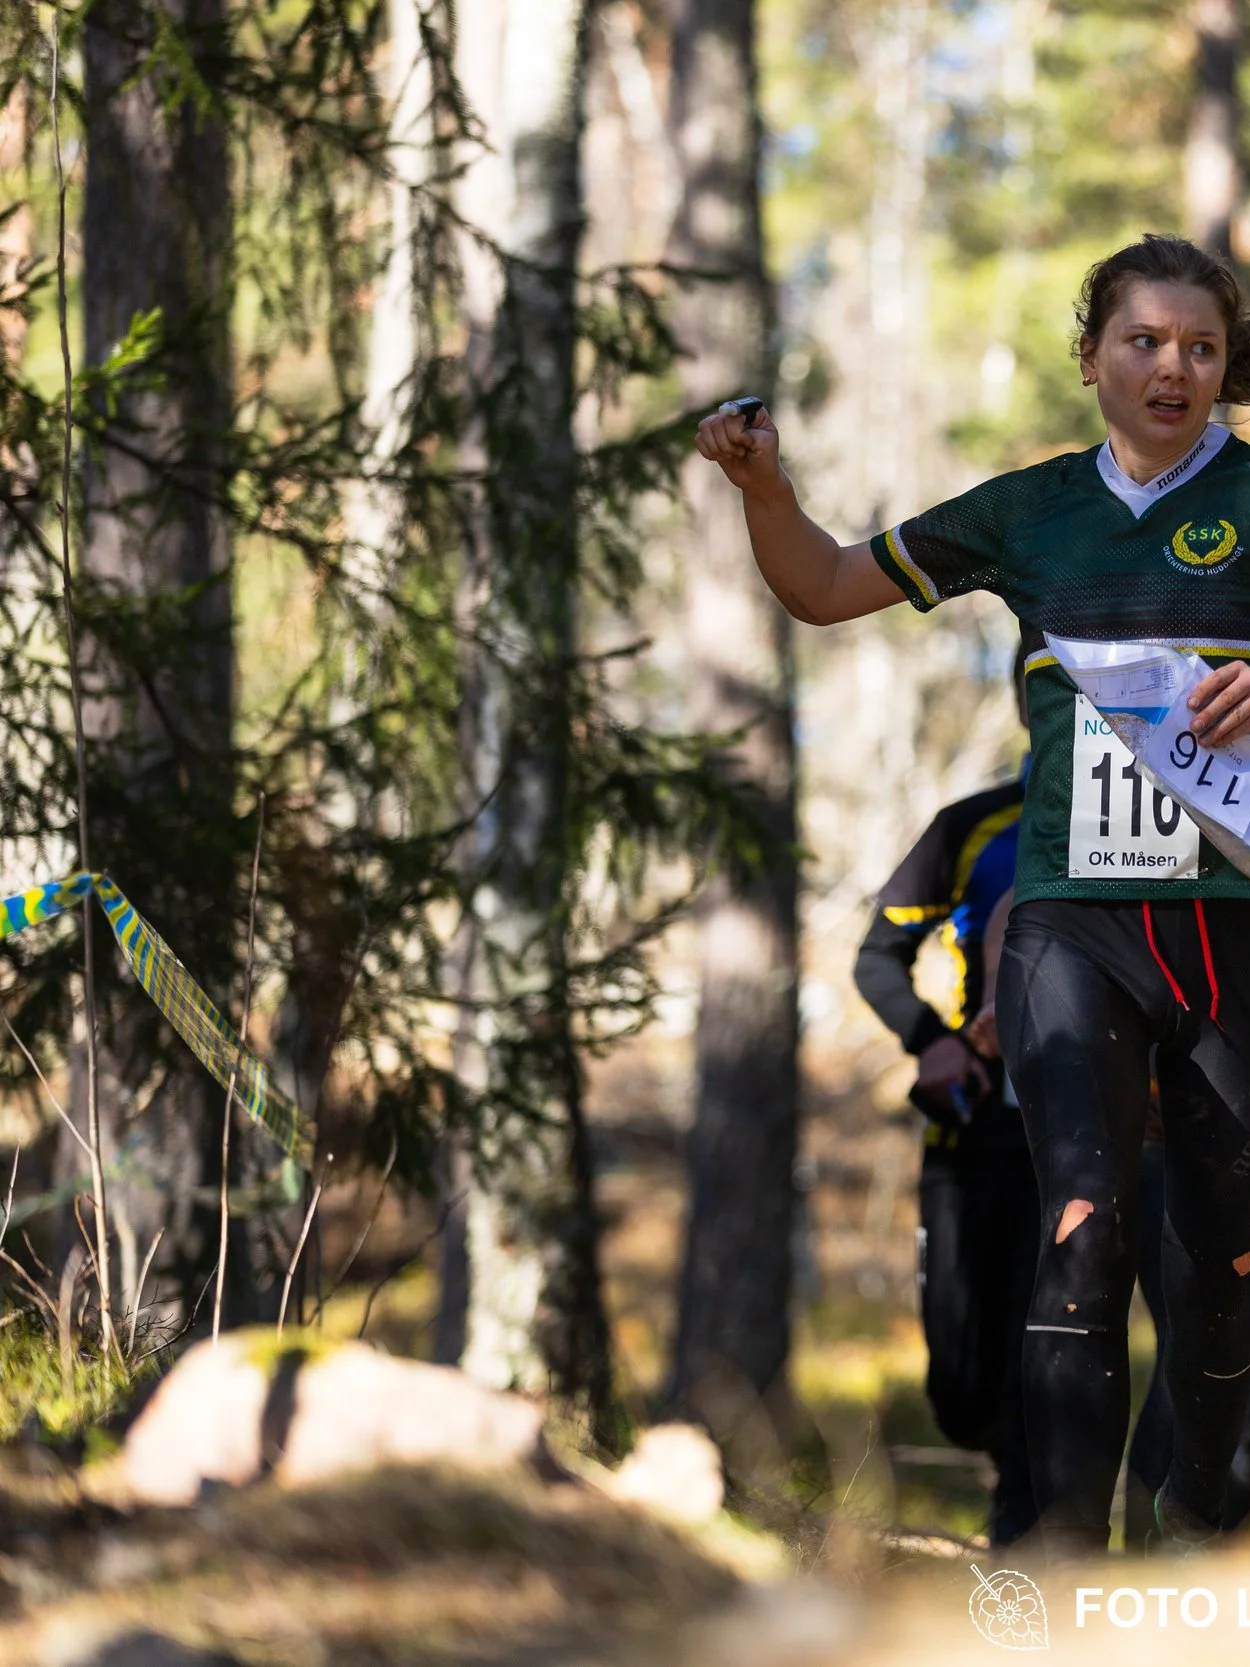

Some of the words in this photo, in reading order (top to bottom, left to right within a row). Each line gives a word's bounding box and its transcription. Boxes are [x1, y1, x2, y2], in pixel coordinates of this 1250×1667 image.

[1156, 440, 1205, 490] noname
[1188, 528, 1222, 541] SSK
[1163, 545, 1204, 576] ORIENTERING
[1207, 545, 1244, 575] HUDDINGE
[1084, 719, 1113, 735] NO
[1170, 731, 1240, 805] 116
[1088, 851, 1116, 866] OK
[1121, 851, 1178, 867] Måsen
